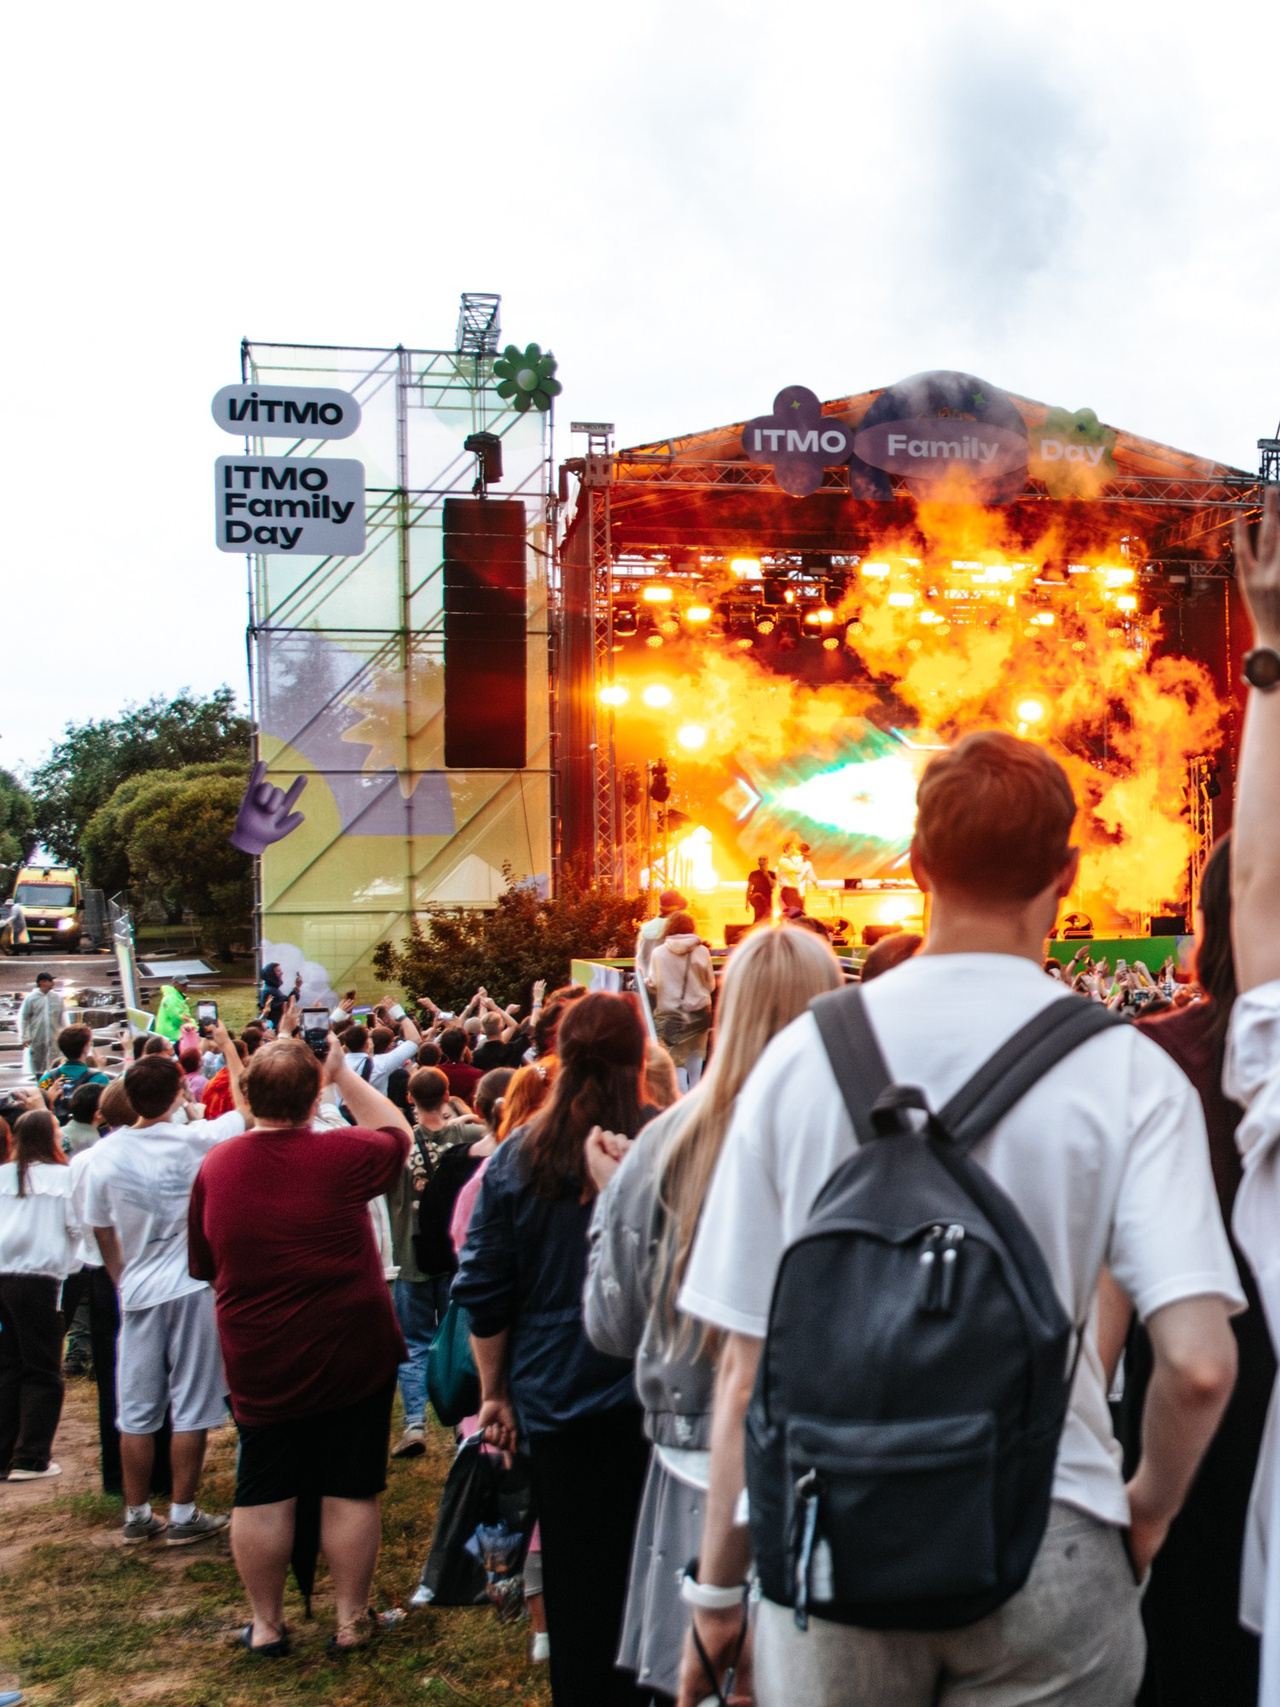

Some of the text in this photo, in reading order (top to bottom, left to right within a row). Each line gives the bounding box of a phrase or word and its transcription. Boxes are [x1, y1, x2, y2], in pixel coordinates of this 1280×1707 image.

[754, 428, 1105, 468] ITMO Family Day
[225, 465, 328, 491] ITMO
[225, 493, 355, 524] Family
[225, 520, 303, 550] Day
